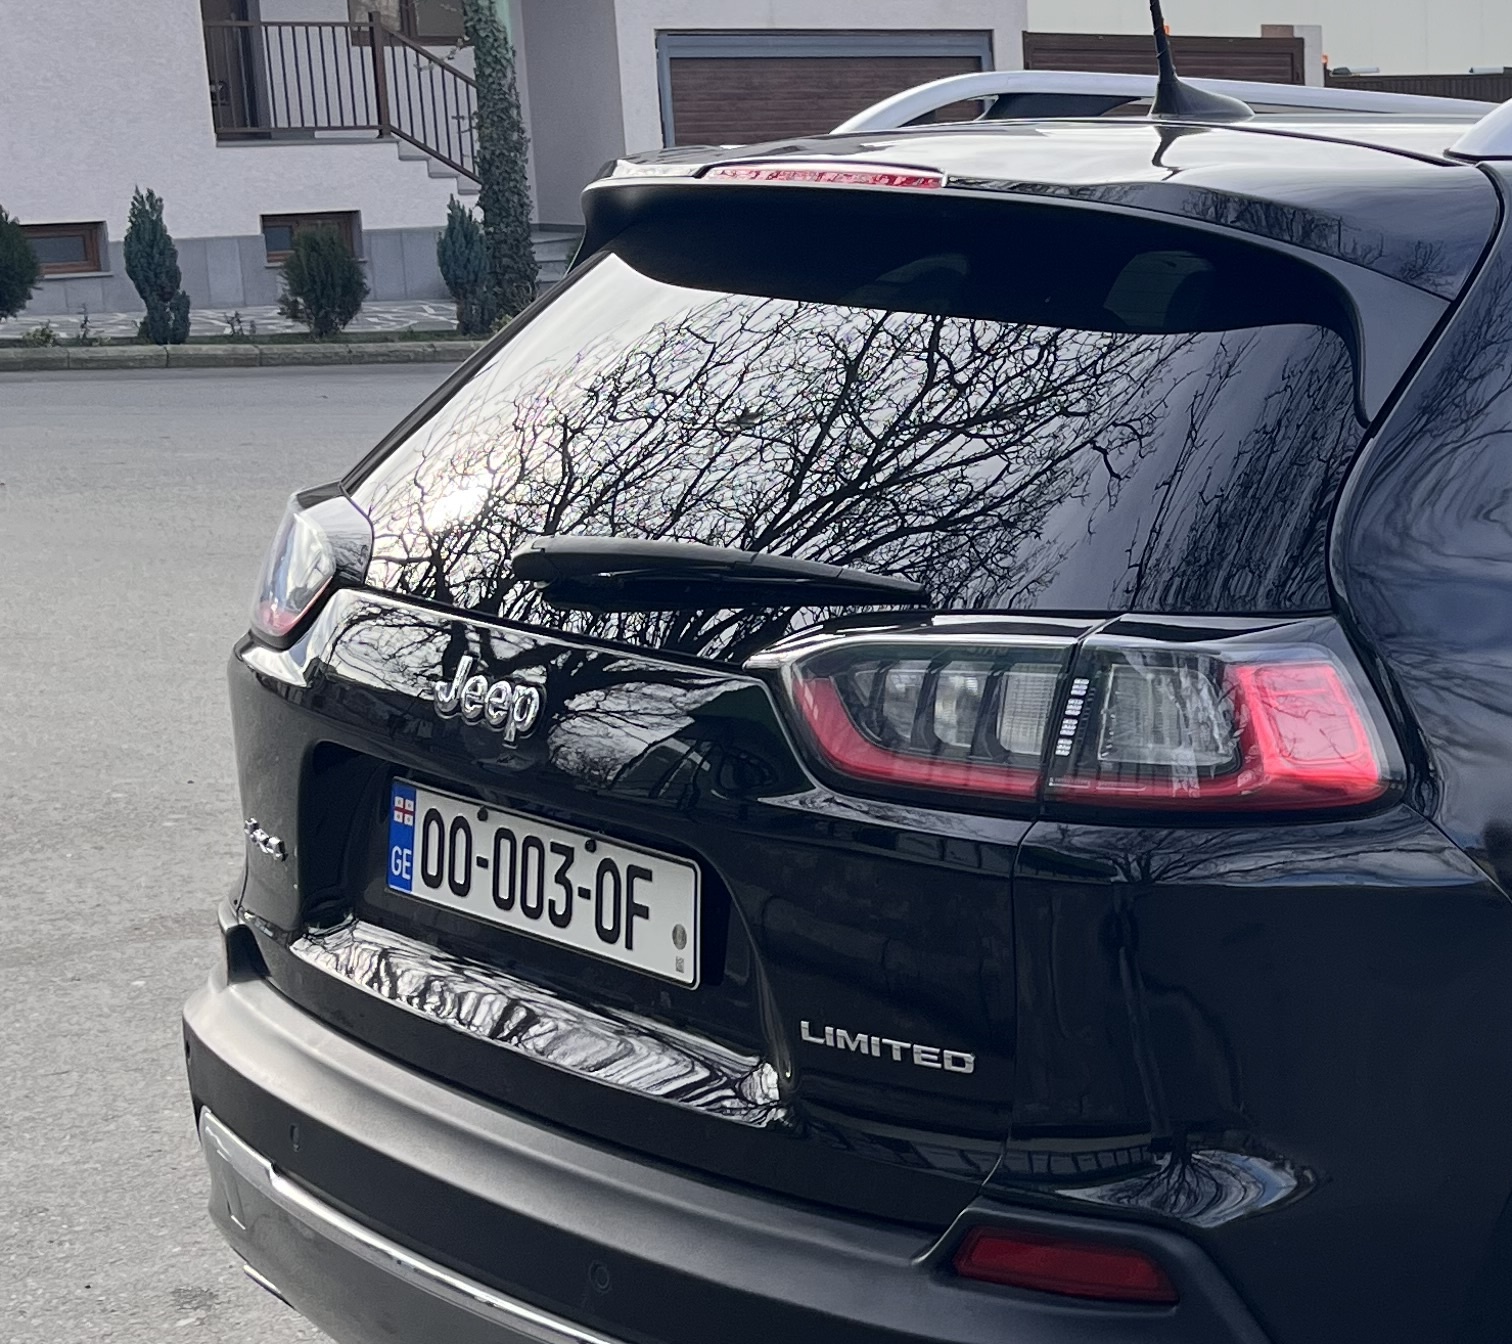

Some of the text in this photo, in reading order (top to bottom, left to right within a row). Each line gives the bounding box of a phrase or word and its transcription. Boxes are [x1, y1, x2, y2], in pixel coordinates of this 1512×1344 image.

[434, 654, 541, 743] Jeep
[390, 845, 413, 881] GE
[799, 1019, 976, 1075] LIMITED
